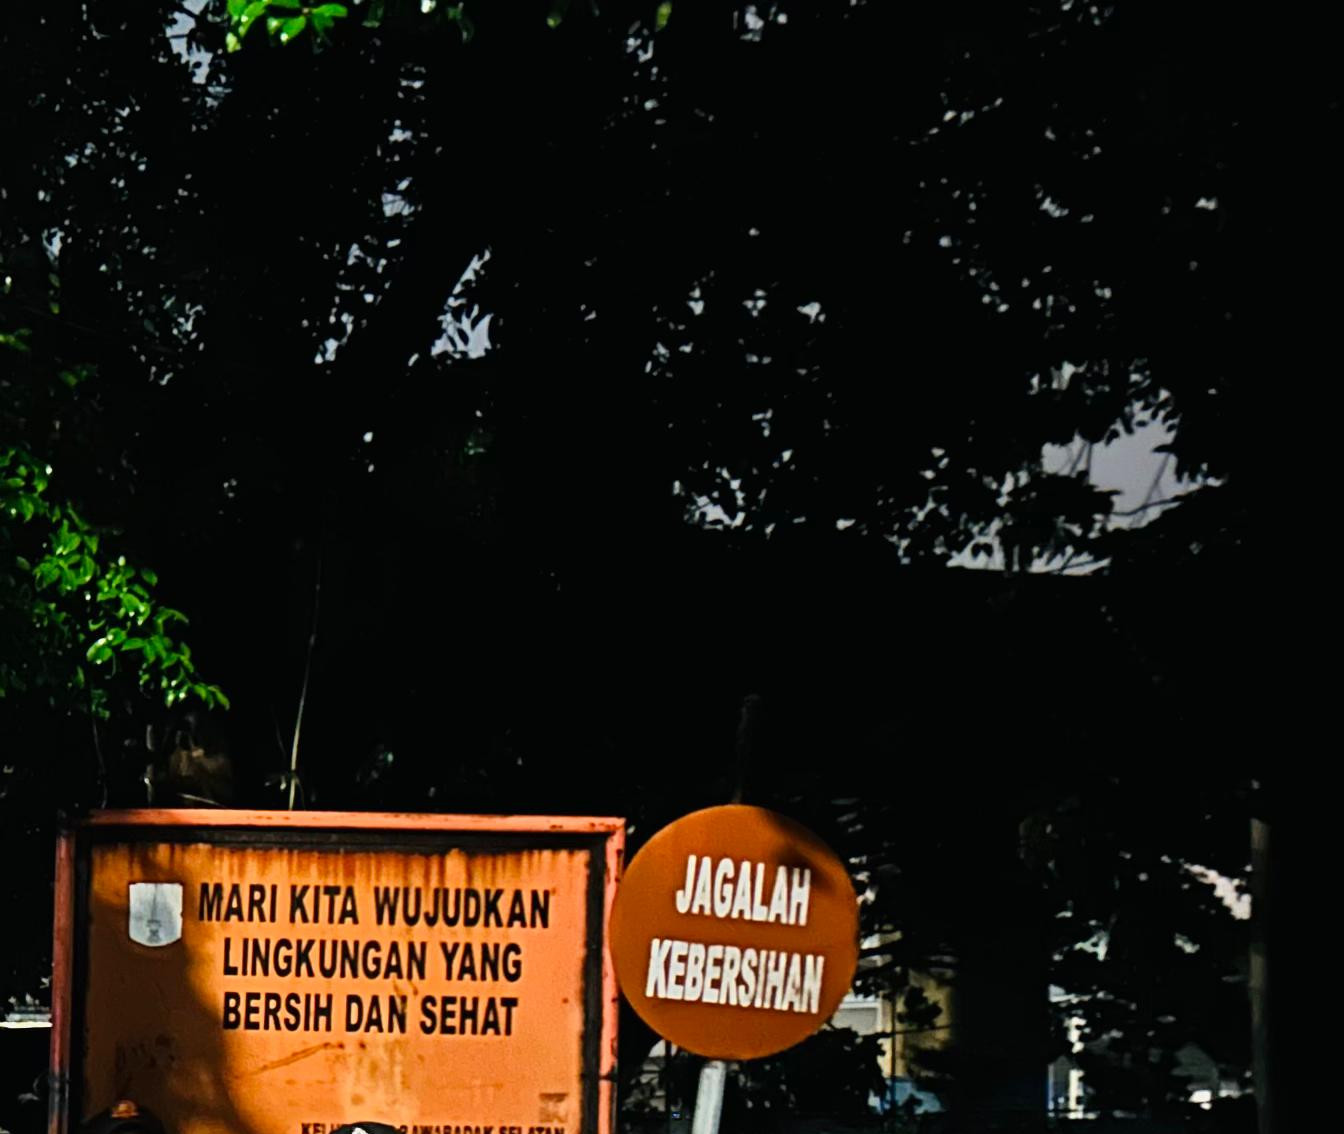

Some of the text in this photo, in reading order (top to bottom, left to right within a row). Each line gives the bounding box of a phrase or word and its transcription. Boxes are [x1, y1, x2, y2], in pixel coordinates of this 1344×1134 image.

[198, 882, 551, 929] MARI KITA WUJUDKAN
[676, 854, 811, 926] JAGALAH
[223, 937, 523, 983] LINGKUNGAN YANG
[645, 937, 825, 1013] KEBERSIHAN
[222, 991, 519, 1036] BERSIH DAN SEHAT
